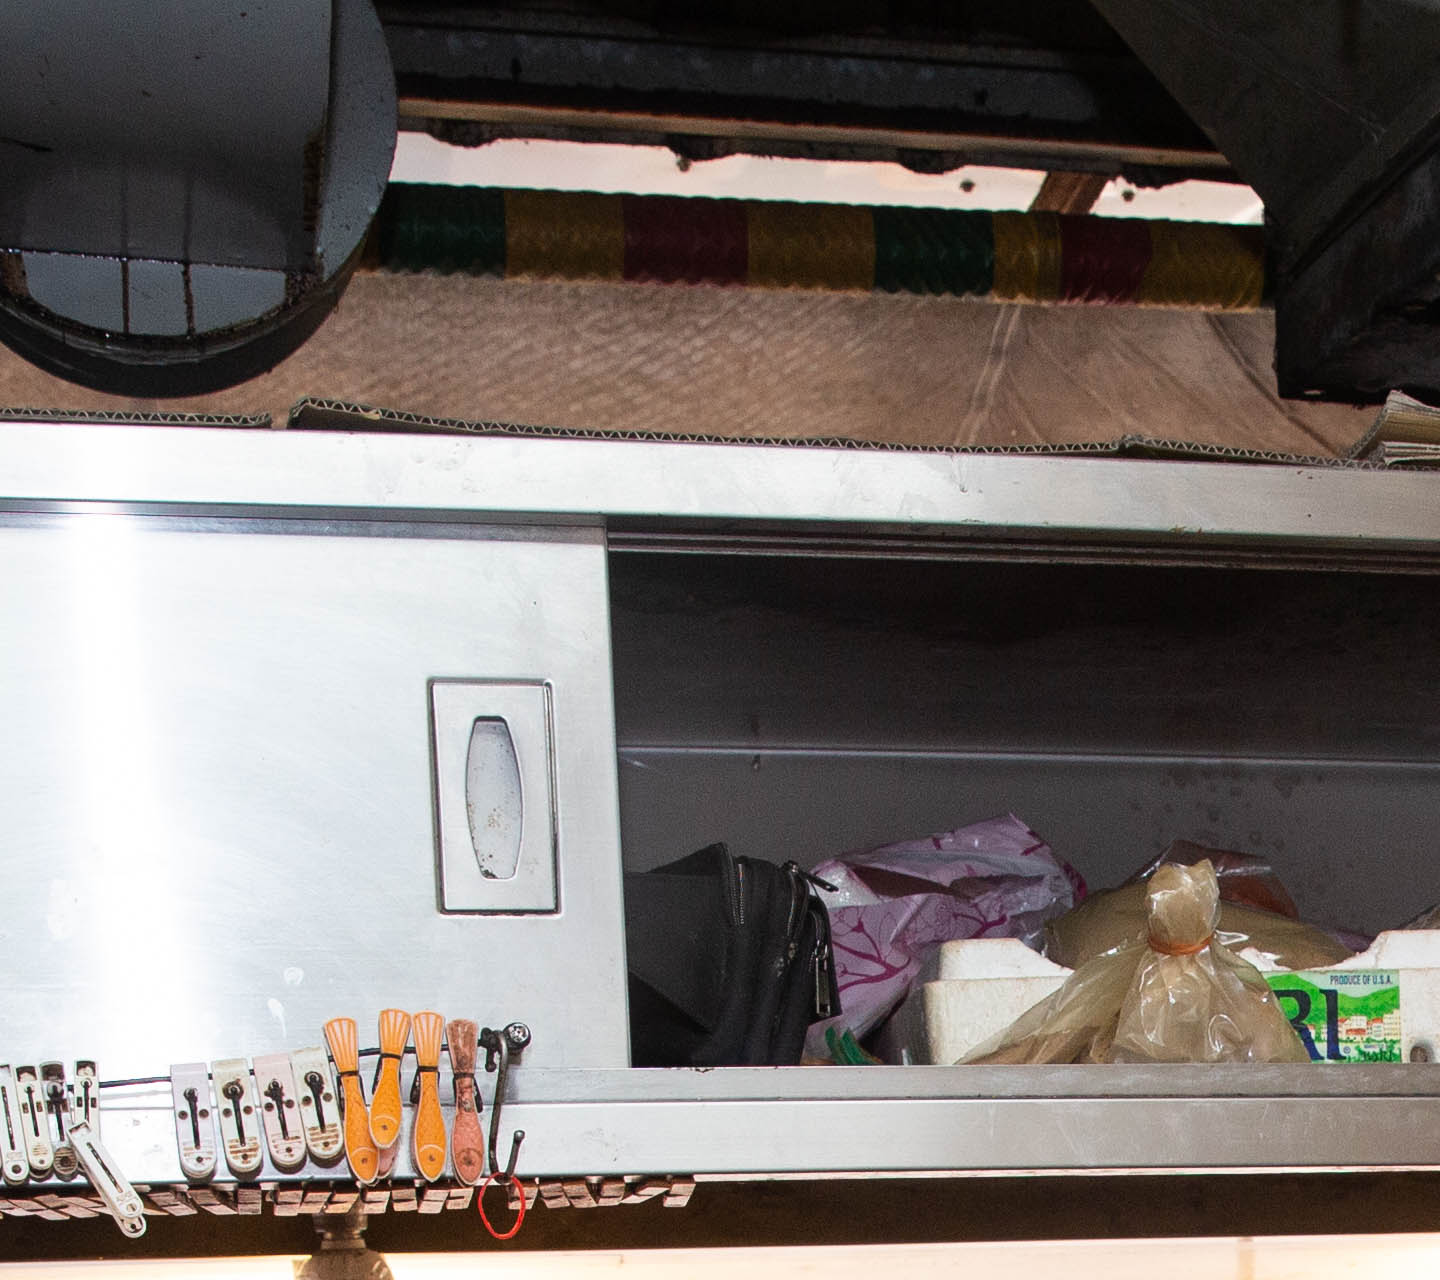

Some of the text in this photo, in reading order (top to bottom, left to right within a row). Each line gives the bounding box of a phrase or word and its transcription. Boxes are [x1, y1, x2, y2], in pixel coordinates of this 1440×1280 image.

[1330, 975, 1392, 985] PRODUCE OF U.S.A.
